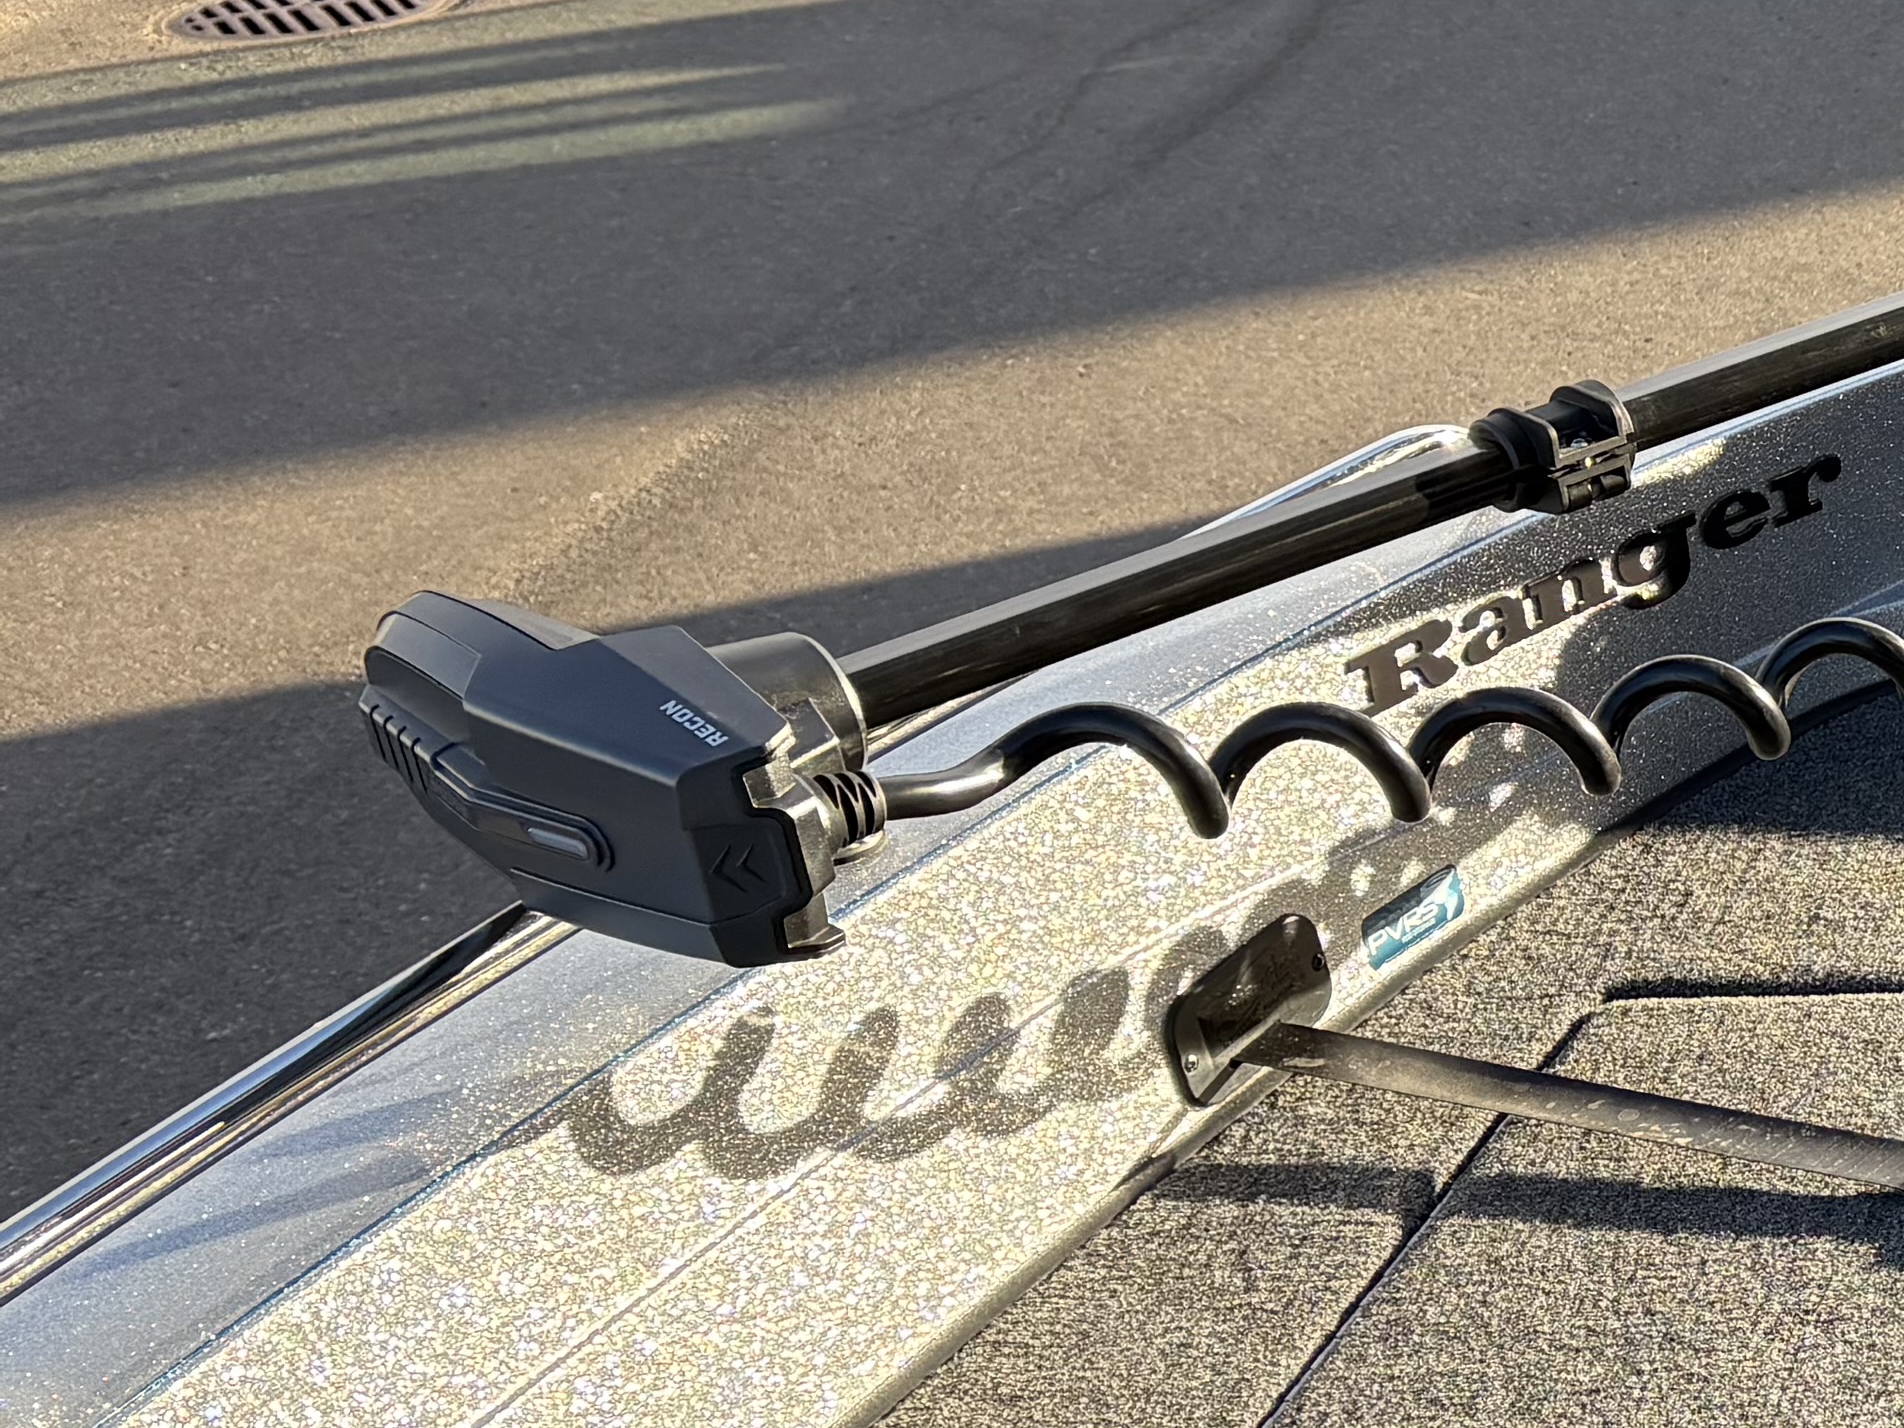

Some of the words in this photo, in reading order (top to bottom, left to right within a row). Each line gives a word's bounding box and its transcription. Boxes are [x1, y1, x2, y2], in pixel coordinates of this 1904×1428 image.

[1346, 454, 1842, 716] Ranger
[659, 700, 729, 747] RECON
[1367, 901, 1438, 956] PVRS
